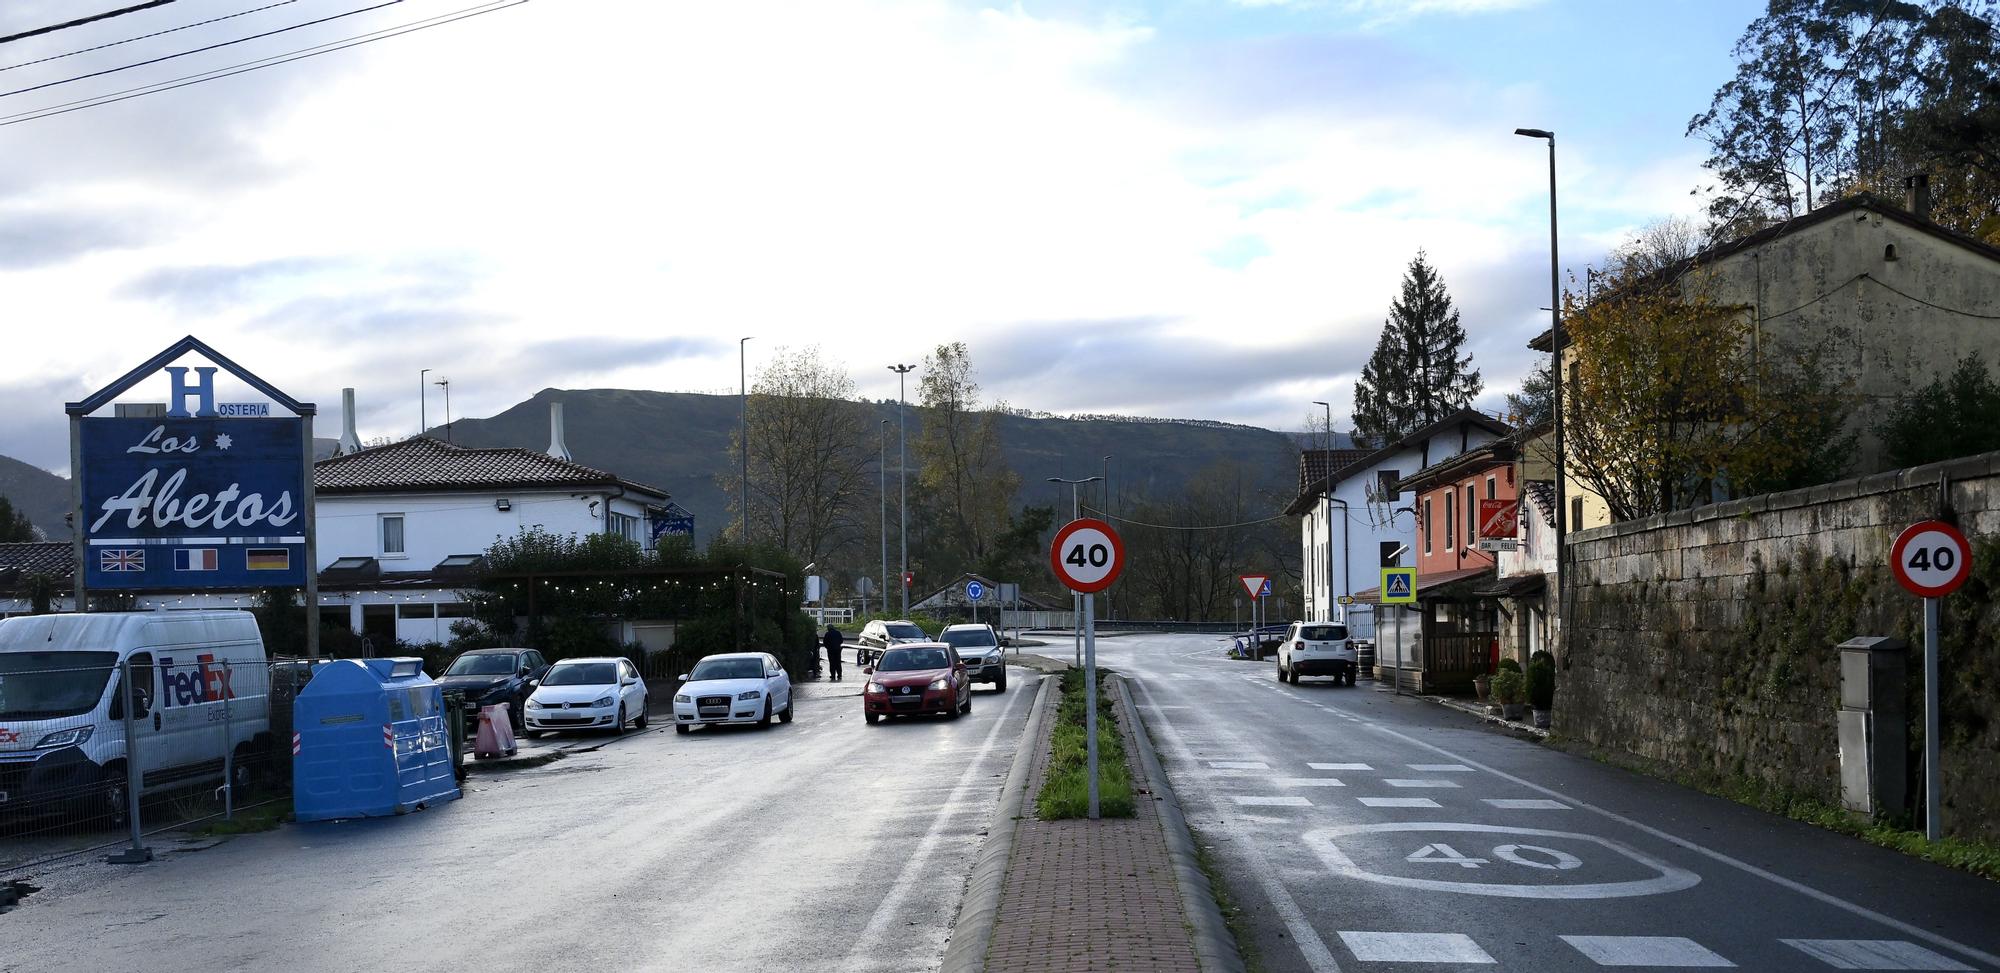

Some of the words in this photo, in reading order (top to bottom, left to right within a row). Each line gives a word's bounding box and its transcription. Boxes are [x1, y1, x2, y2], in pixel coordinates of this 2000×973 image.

[127, 425, 200, 453] Los
[90, 468, 297, 533] Abetos
[1066, 544, 1108, 567] 40
[1501, 542, 1516, 550] FELIX
[1908, 546, 1954, 571] 40
[159, 654, 236, 707] FedEx
[208, 707, 233, 721] Expres
[1406, 843, 1583, 870] 40
